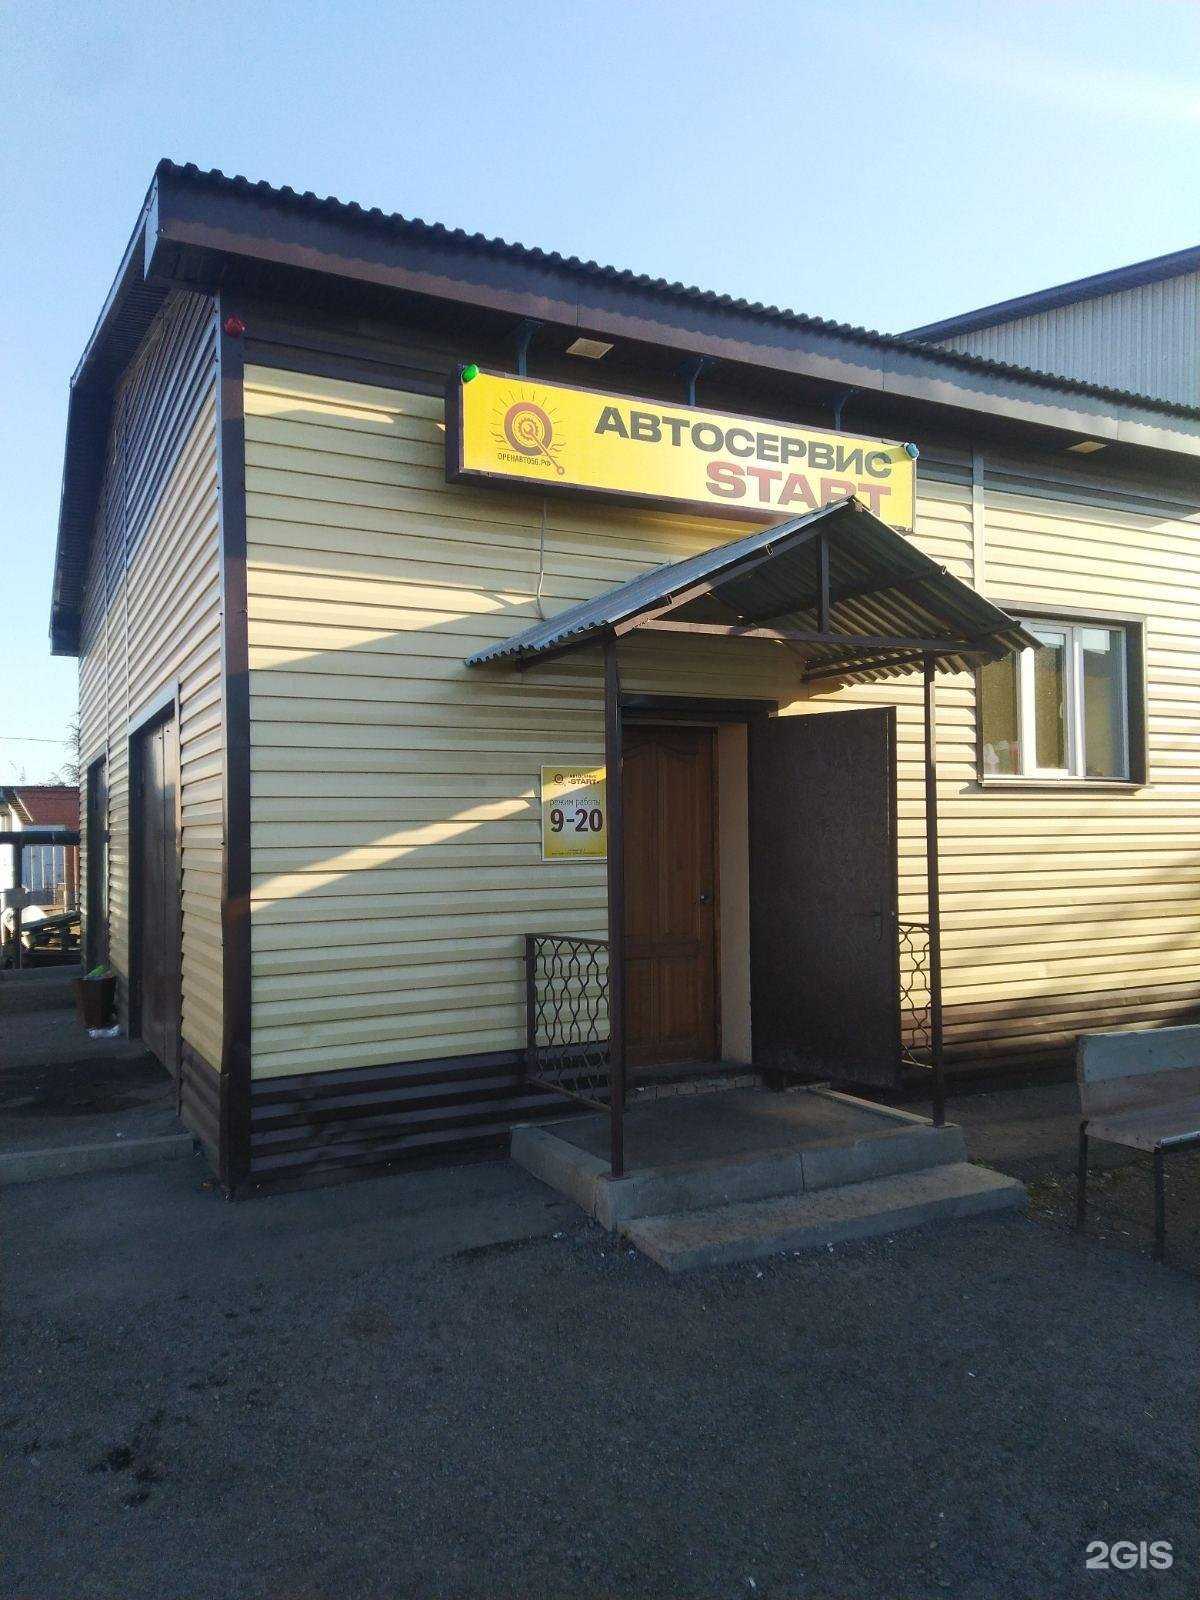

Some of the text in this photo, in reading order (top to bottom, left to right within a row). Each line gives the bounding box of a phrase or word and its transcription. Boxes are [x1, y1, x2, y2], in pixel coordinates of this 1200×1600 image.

[594, 406, 892, 479] АВТОСЕРВИС
[705, 460, 892, 517] START
[550, 808, 603, 833] 9-20
